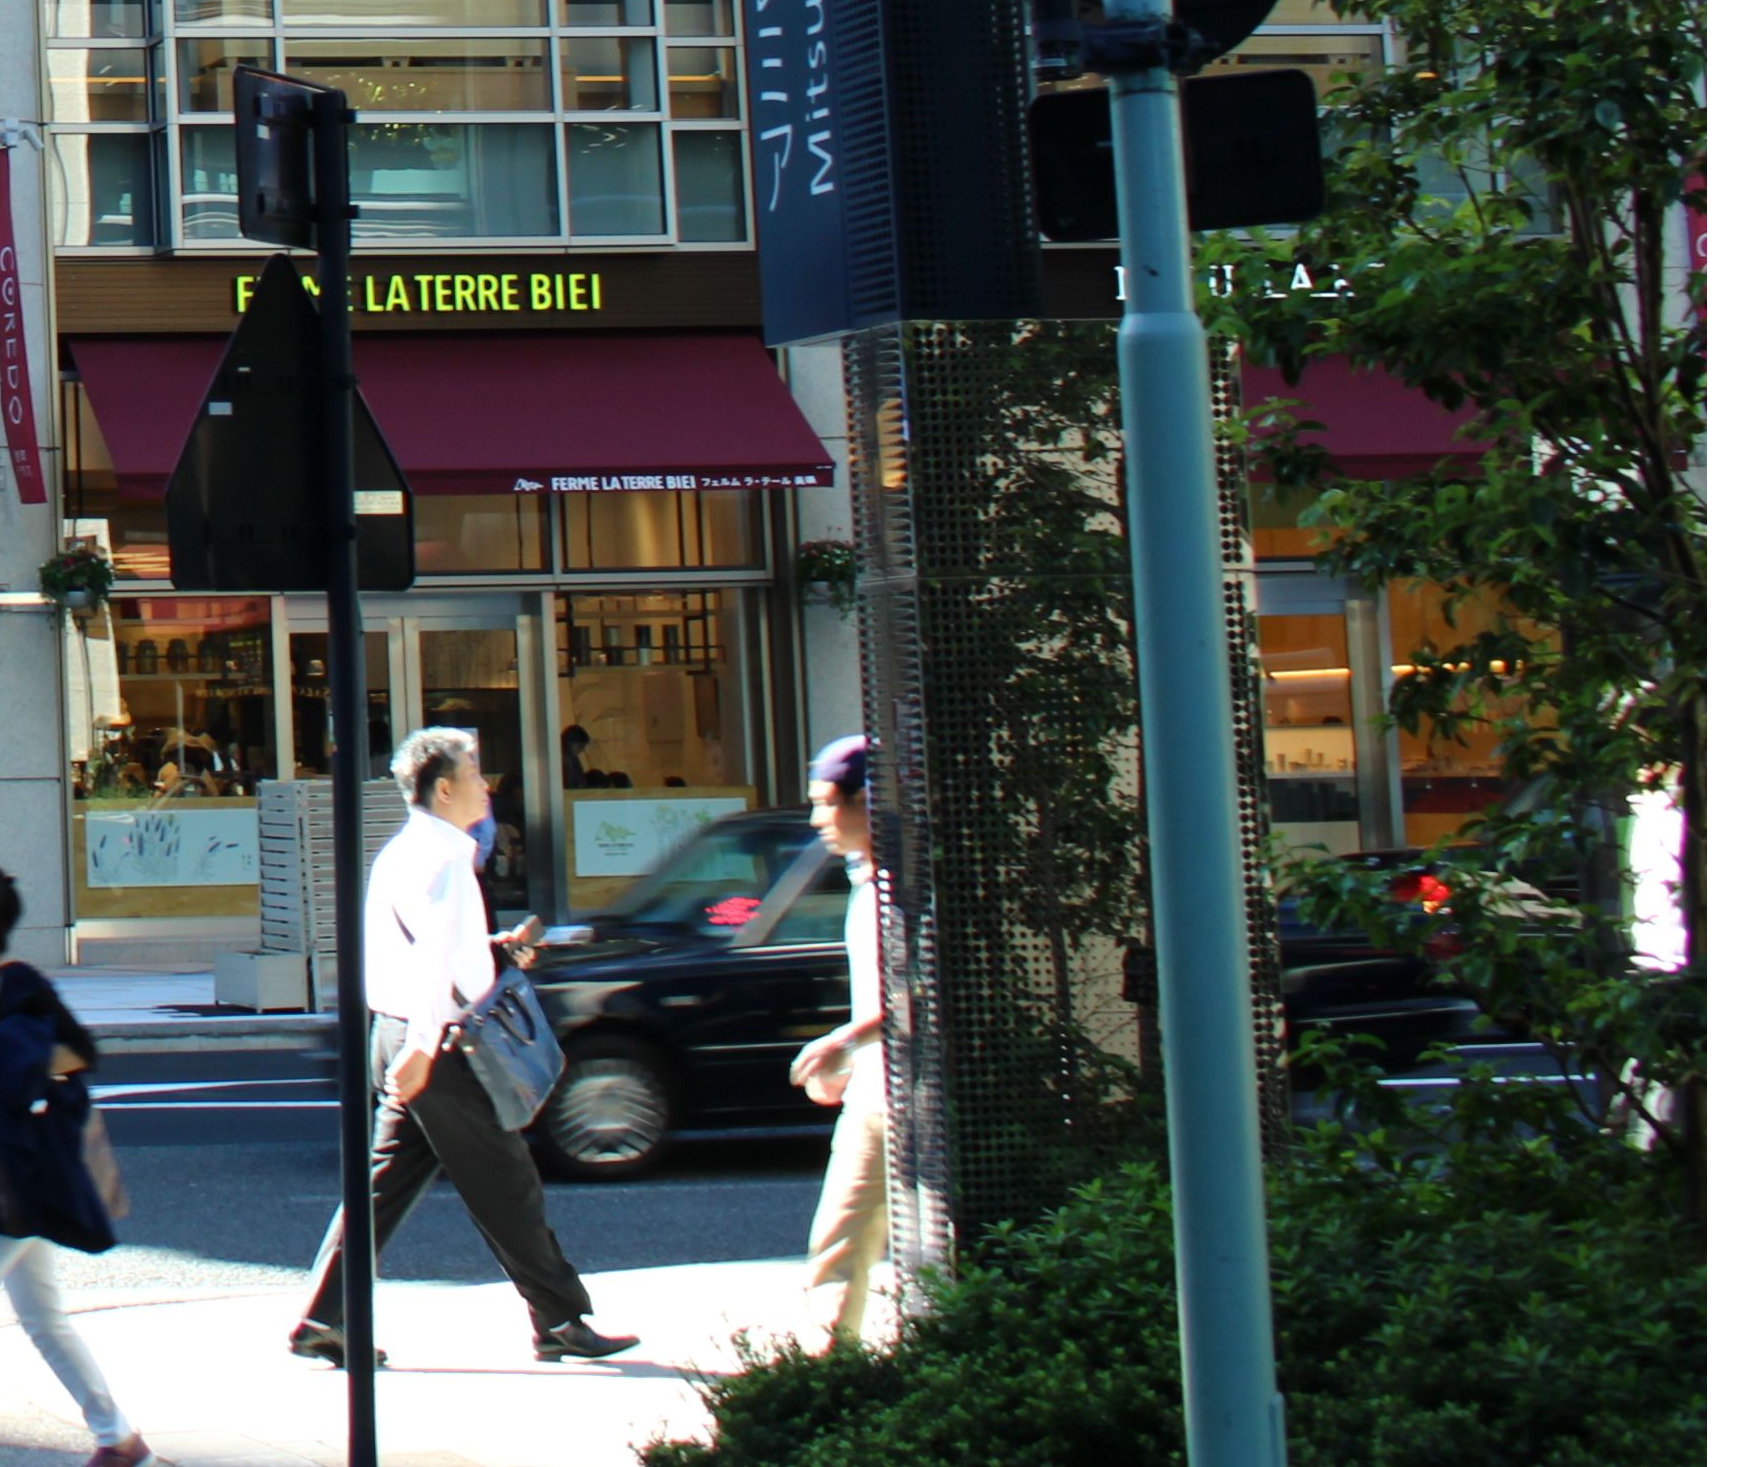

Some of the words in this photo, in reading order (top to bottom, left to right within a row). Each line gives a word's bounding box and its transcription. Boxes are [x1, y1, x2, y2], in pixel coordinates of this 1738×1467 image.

[531, 273, 602, 311] BIEI
[0, 246, 22, 425] COREDO
[551, 476, 600, 491] FERME
[665, 475, 697, 490] BIEI
